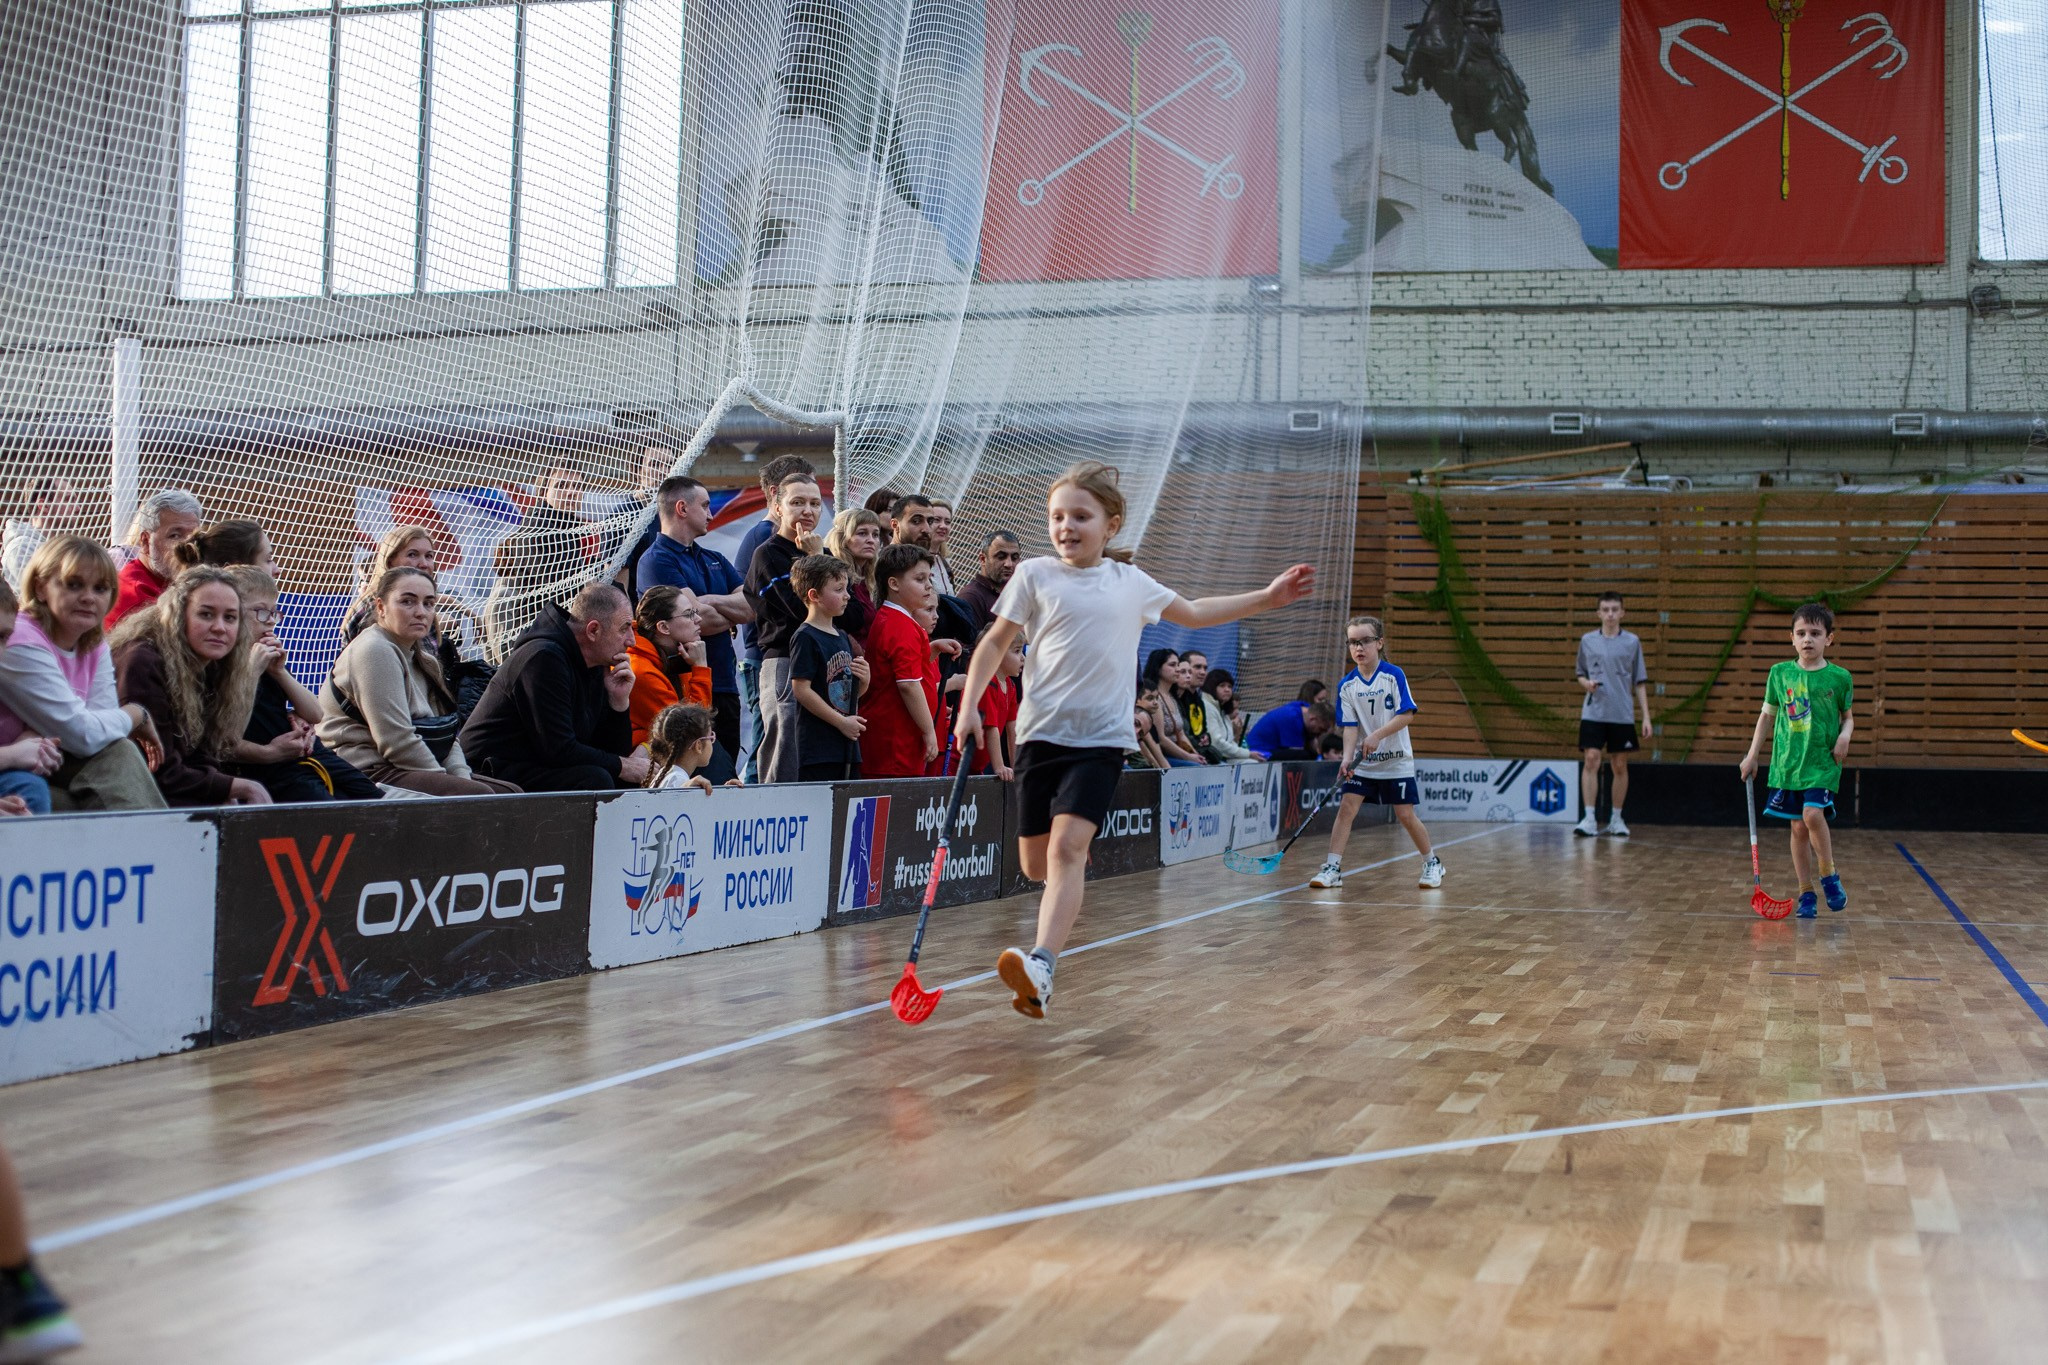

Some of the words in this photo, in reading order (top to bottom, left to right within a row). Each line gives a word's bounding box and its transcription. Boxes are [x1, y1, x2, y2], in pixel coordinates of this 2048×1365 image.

[1368, 699, 1375, 716] 7
[1398, 782, 1407, 800] 7
[1416, 769, 1460, 783] Floorball
[1463, 768, 1489, 783] club
[1425, 787, 1449, 800] Nord
[1451, 787, 1473, 803] City
[713, 815, 809, 860] МИНСПОРТ
[915, 794, 978, 841] нфф.рф
[724, 866, 793, 912] РОССИИ
[893, 843, 995, 890] #russifloorball
[0, 864, 154, 939] СПОРТ
[356, 864, 565, 937] OXDOG
[0, 950, 117, 1027] ССИИ
